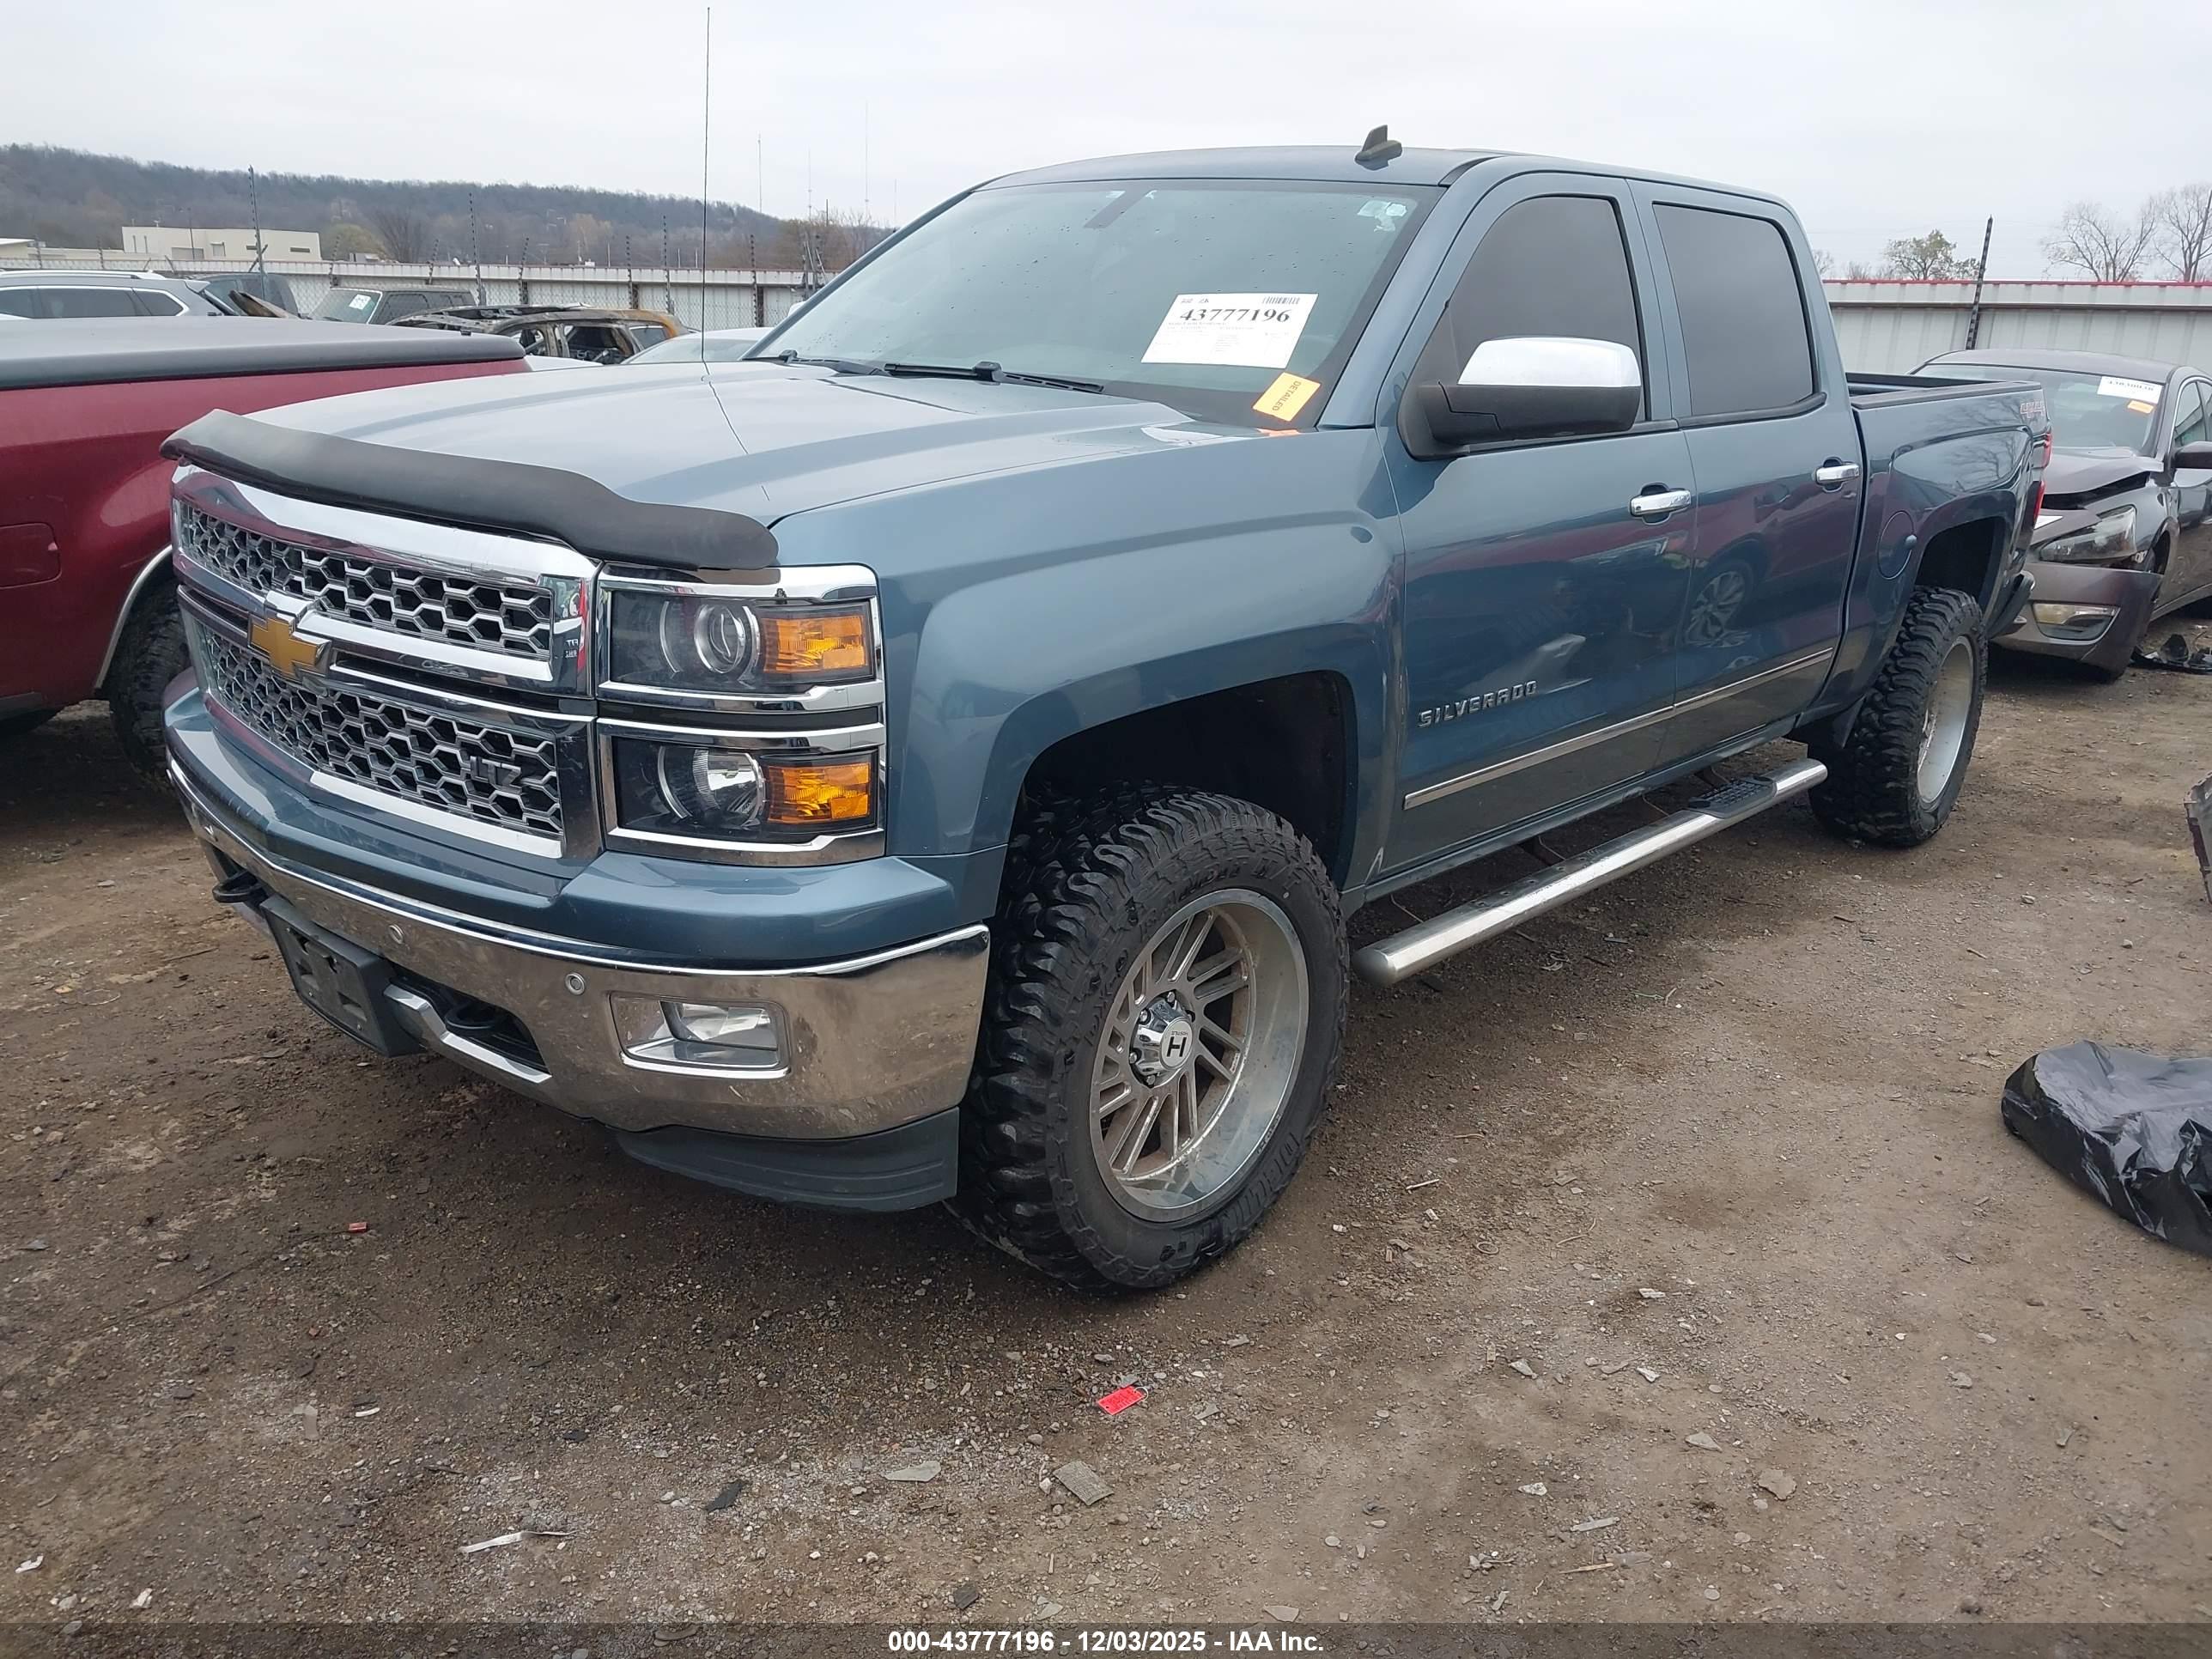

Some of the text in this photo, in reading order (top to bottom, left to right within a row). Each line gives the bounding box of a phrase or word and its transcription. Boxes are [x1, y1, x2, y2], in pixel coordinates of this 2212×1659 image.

[1180, 309, 1291, 323] 43777196
[1272, 380, 1302, 411] DETAILED
[1418, 680, 1537, 728] SILVERADO
[470, 755, 523, 793] LTZ
[1166, 1036, 1188, 1057] H
